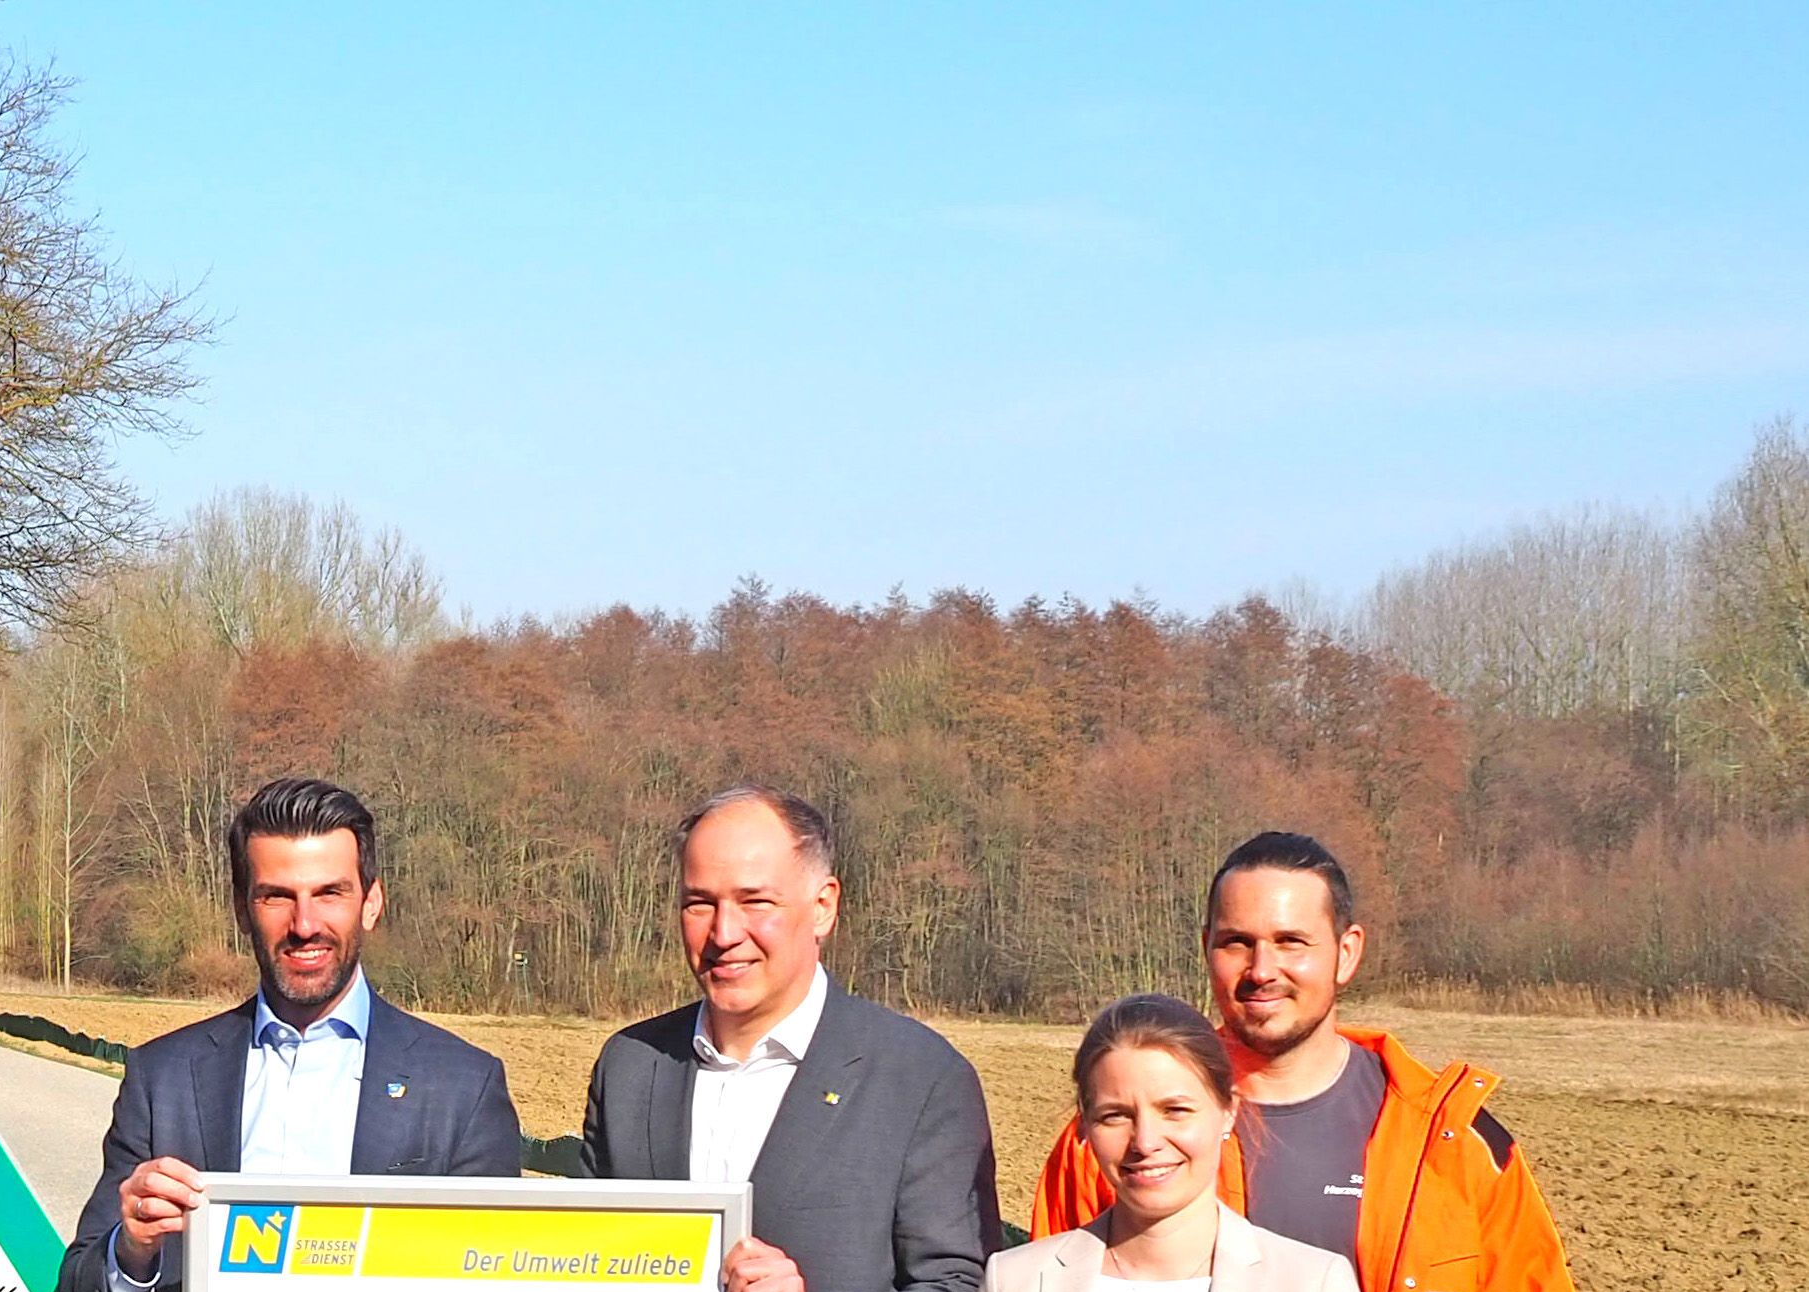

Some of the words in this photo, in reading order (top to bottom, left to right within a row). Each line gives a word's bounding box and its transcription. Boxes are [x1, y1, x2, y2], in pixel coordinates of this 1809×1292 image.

[227, 1213, 282, 1265] N
[295, 1239, 358, 1252] STRASSEN
[310, 1253, 355, 1265] DIENST
[463, 1249, 504, 1272] Der
[512, 1250, 600, 1275] Umwelt
[606, 1253, 692, 1276] zuliebe
